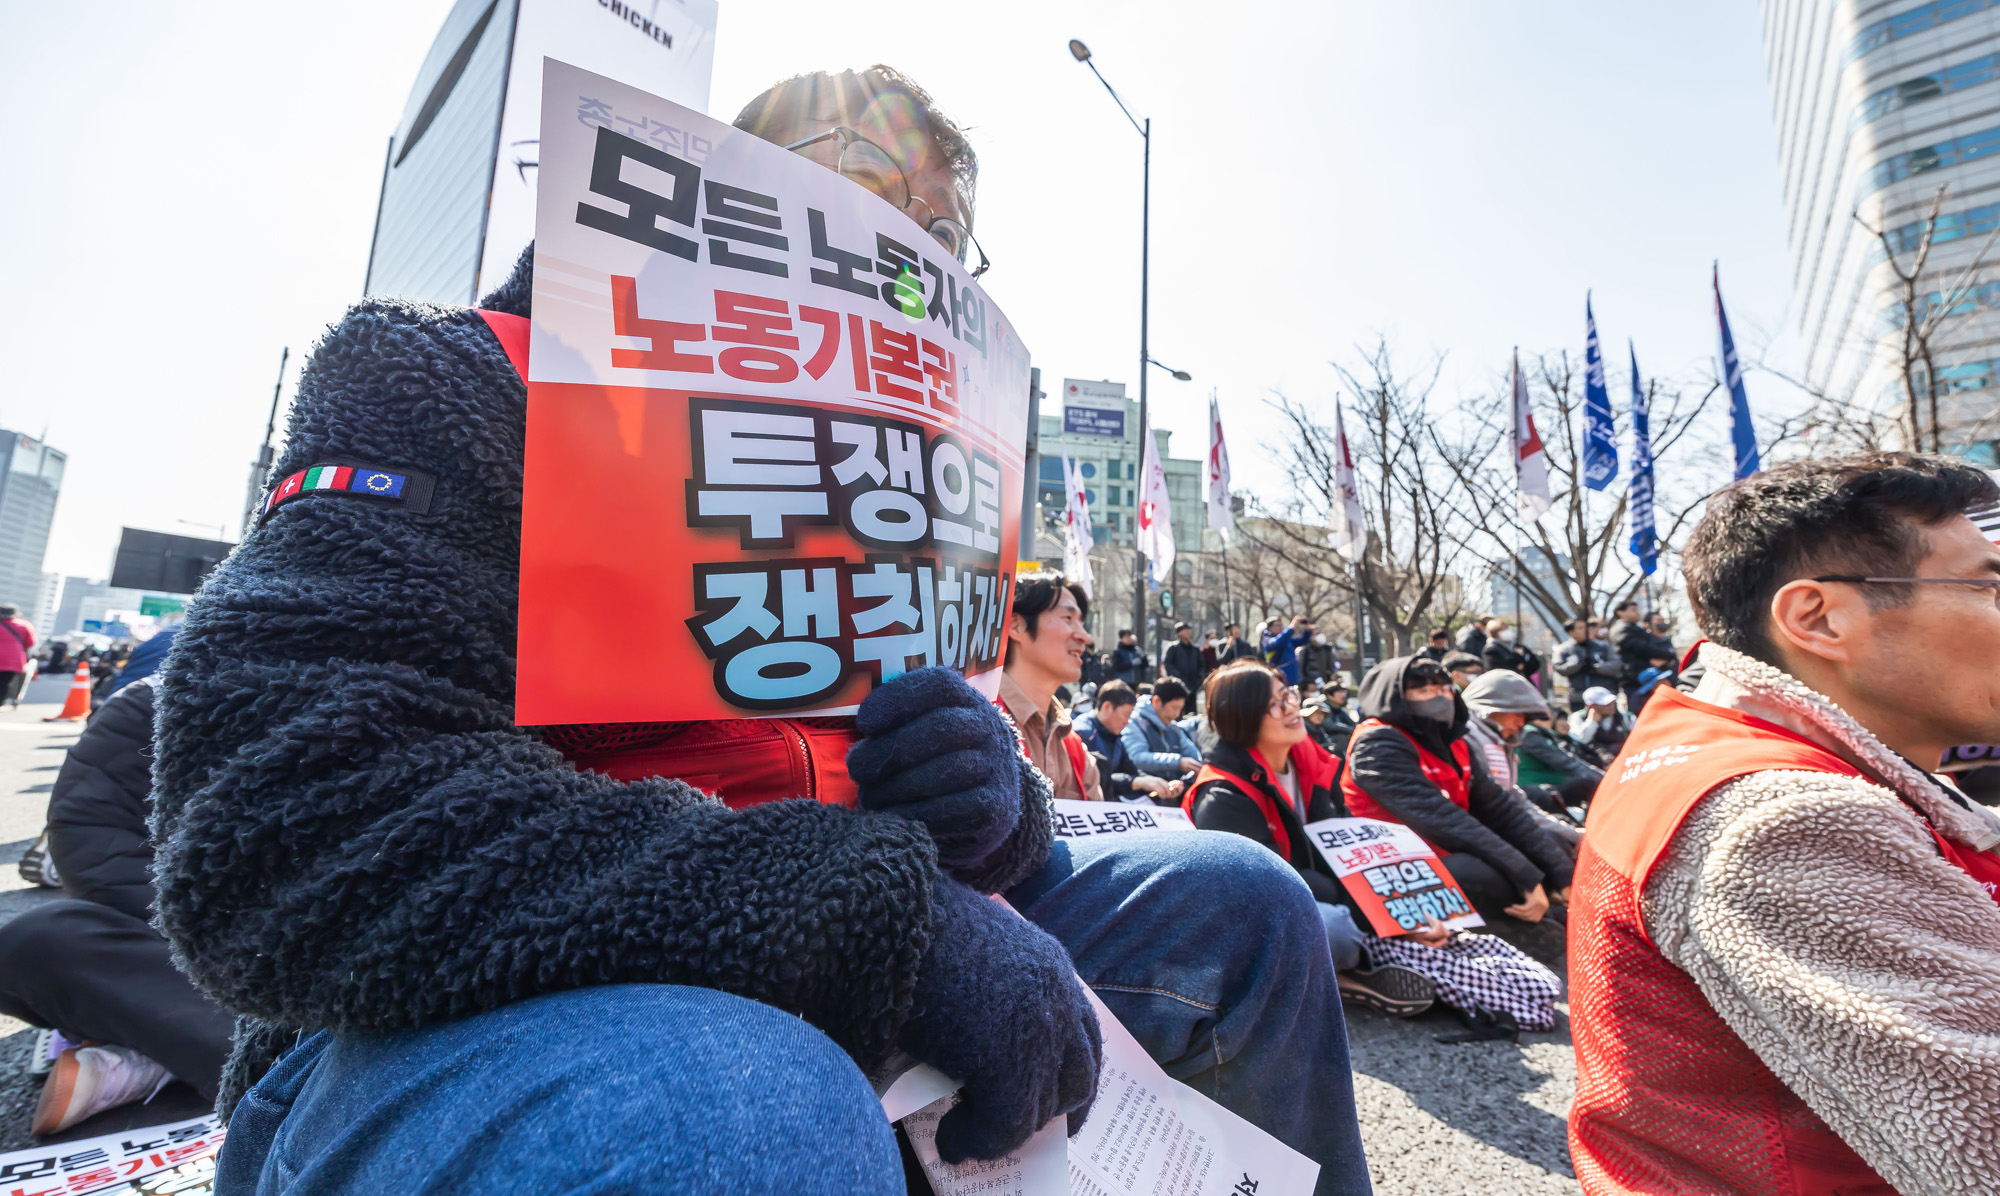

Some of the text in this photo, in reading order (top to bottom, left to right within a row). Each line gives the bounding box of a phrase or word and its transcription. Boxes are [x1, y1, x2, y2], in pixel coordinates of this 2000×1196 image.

[576, 126, 988, 360] 모든 노동자의
[611, 274, 961, 420] 노동기본권
[698, 409, 1000, 554] 투쟁으로
[702, 562, 1008, 699] 쟁취하자!
[1087, 809, 1158, 834] 노동자의
[1317, 828, 1355, 849] 모든
[1362, 860, 1443, 897] 투쟁으로
[0, 1147, 109, 1185] 모든
